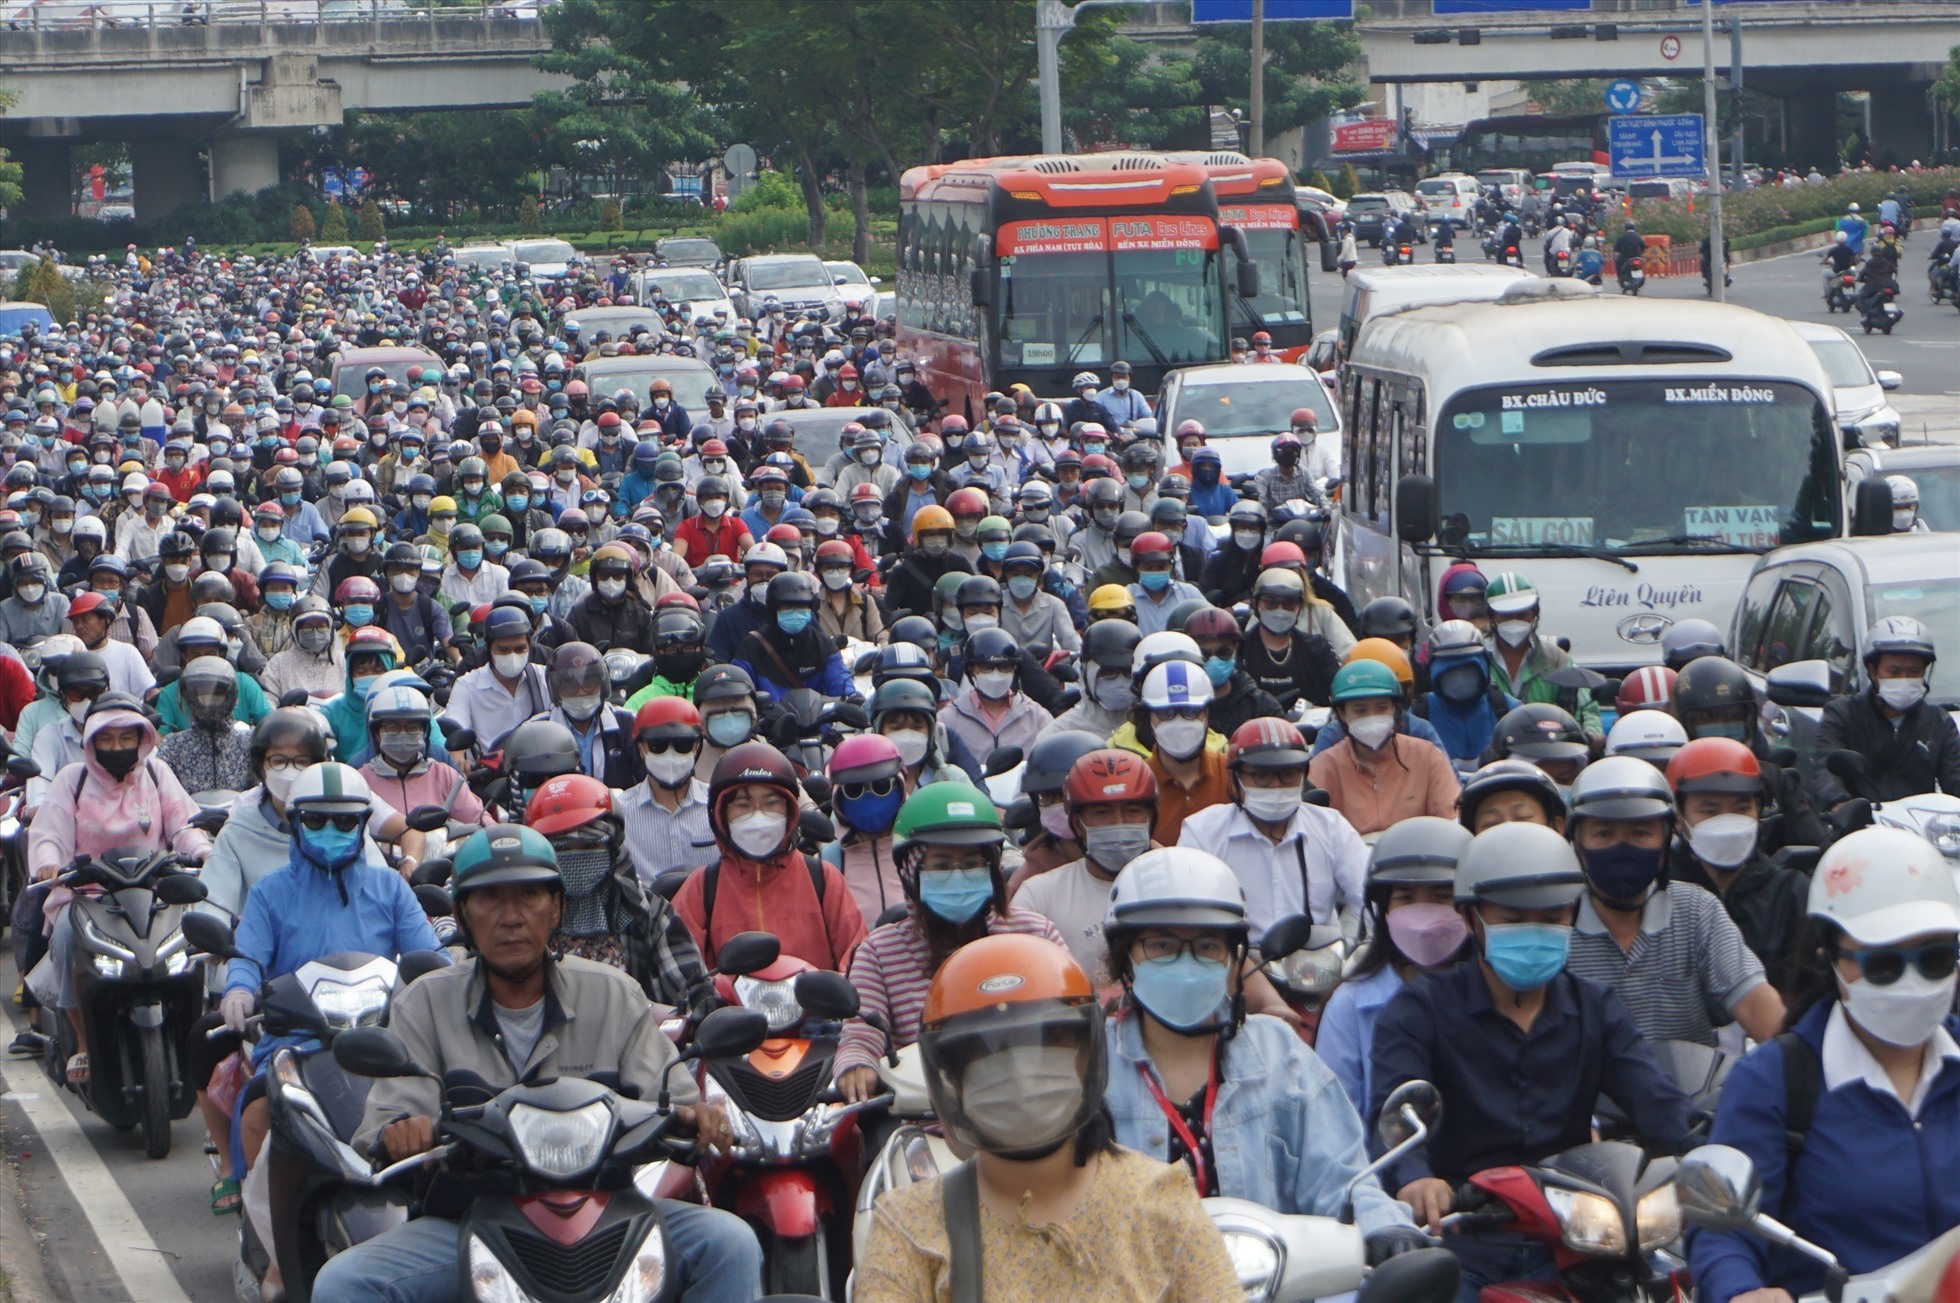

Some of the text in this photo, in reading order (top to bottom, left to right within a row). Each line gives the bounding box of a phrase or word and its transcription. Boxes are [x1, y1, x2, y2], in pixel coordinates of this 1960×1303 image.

[1062, 223, 1100, 238] TRANG
[1113, 221, 1207, 237] FUTA Bus Lines
[1045, 243, 1062, 252] NAM
[1117, 237, 1201, 248] BẾN XE MIỀN ĐÔNG
[1502, 387, 1607, 408] BX.CHÂU ĐỨC
[1665, 382, 1775, 402] BX.MIỀN ĐÔNG
[1579, 582, 1702, 609] Liên Quyền
